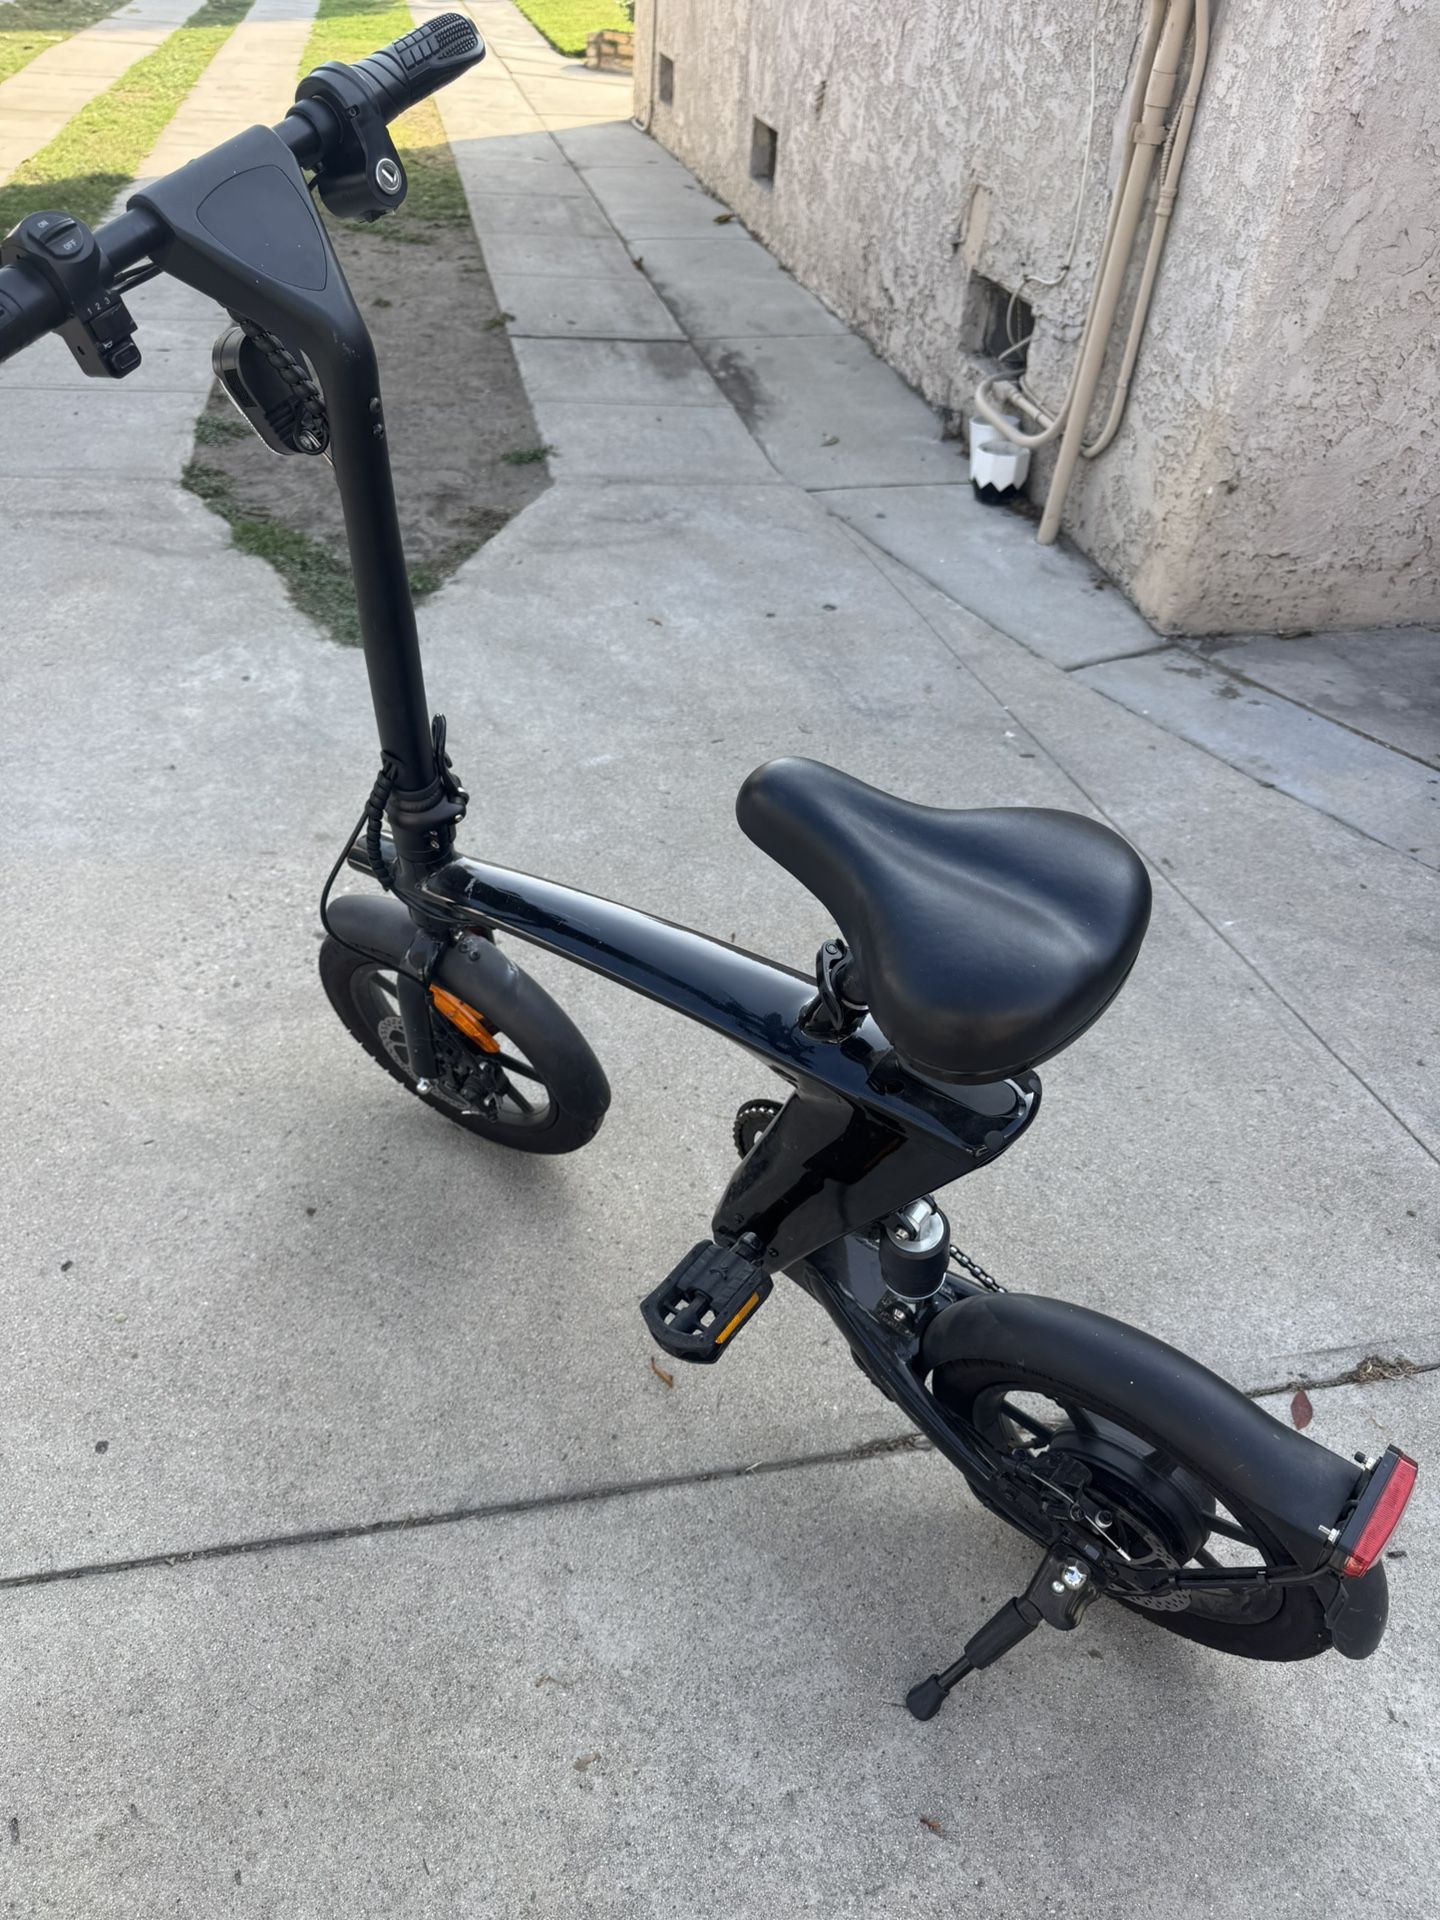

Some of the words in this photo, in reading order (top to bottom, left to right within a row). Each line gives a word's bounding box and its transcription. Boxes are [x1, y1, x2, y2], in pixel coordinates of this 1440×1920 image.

[37, 219, 49, 229] ON
[63, 239, 77, 250] OFF
[95, 302, 102, 311] 2
[104, 296, 111, 305] 3
